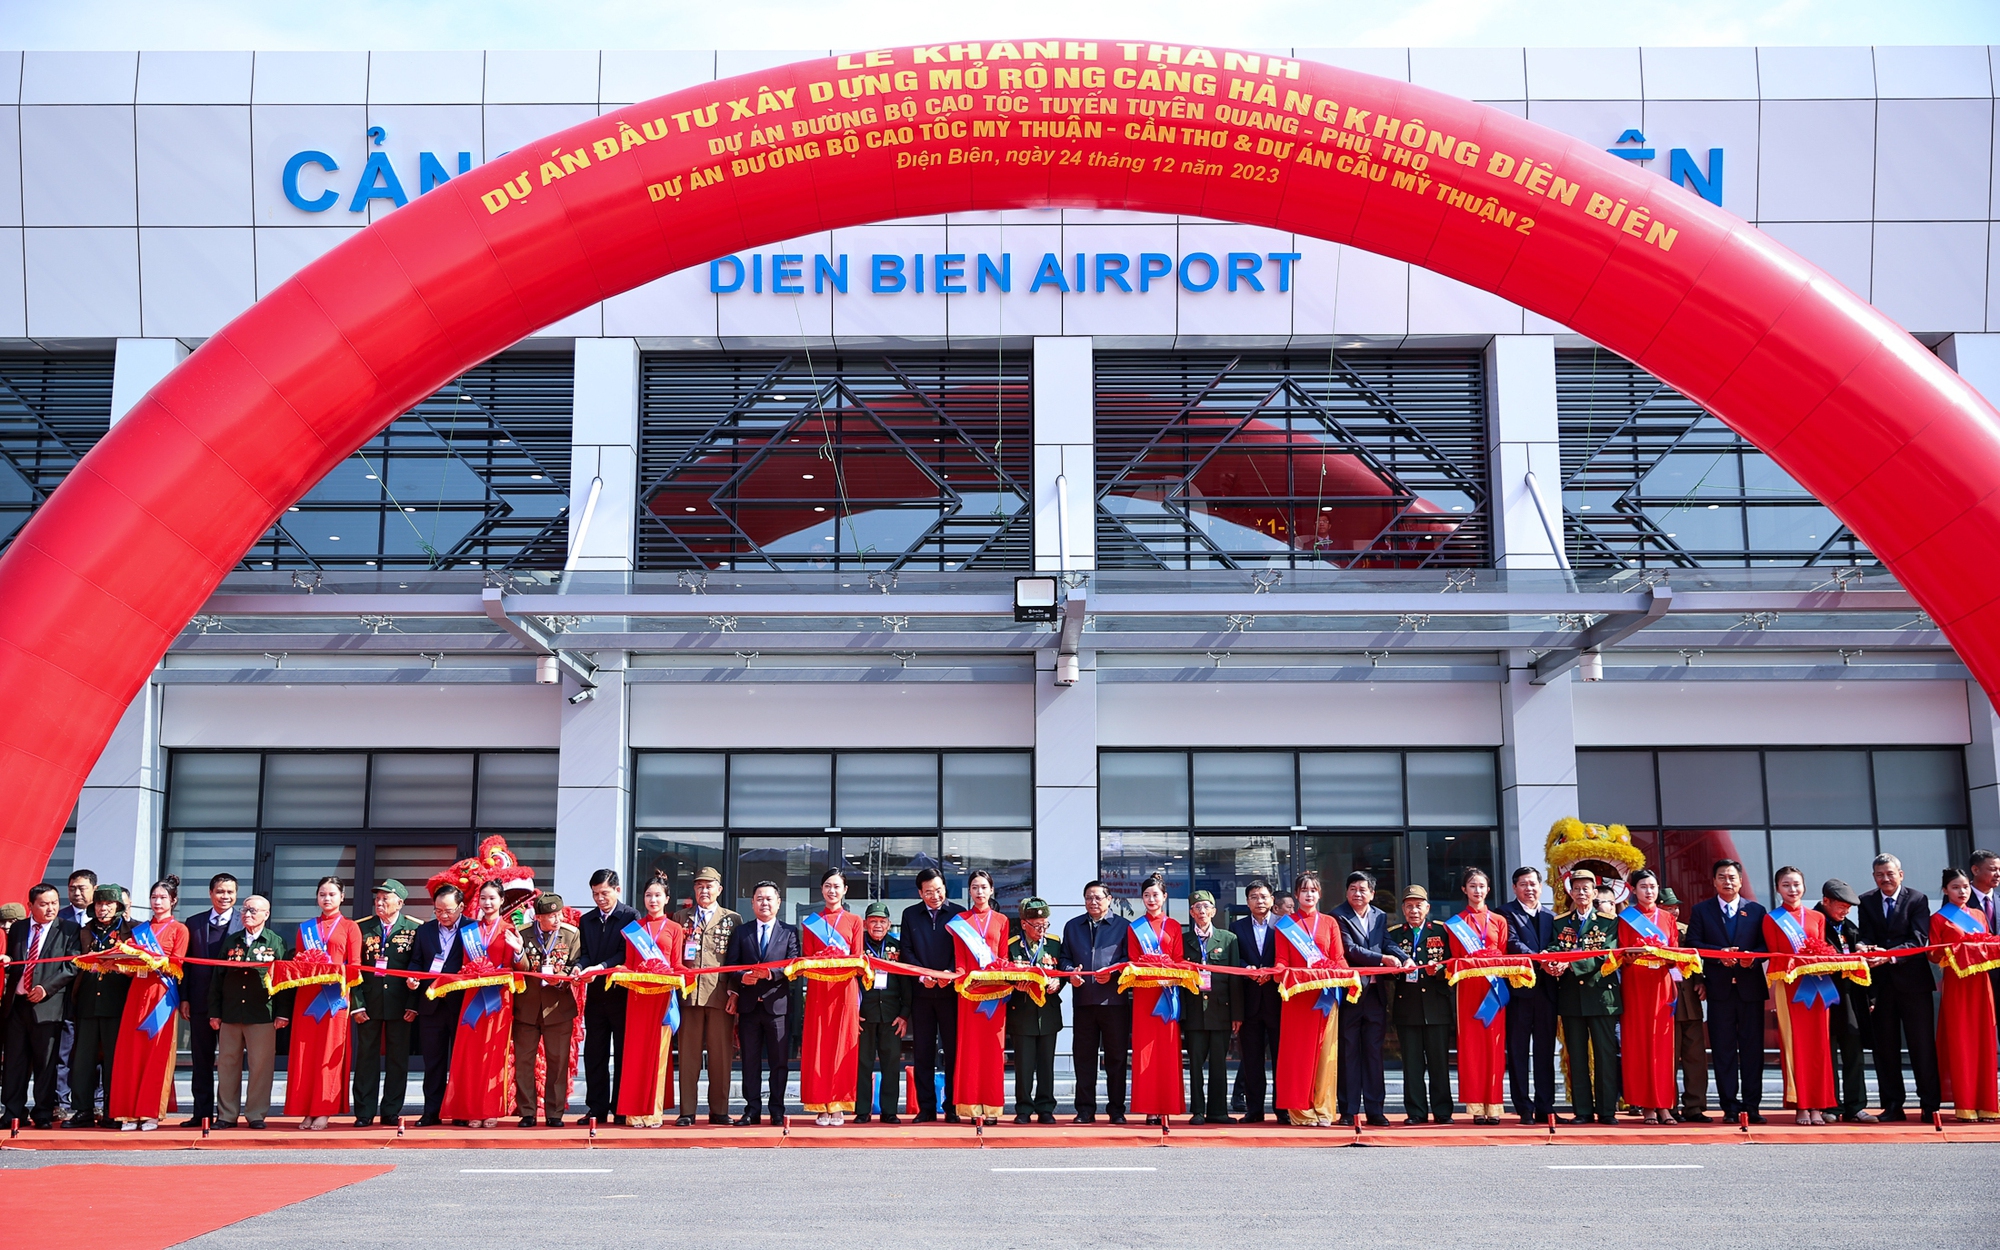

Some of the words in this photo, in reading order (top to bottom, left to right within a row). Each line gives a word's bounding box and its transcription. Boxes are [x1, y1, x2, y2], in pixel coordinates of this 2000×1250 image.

[283, 126, 511, 212] CẢN
[481, 170, 533, 215] DỰ
[539, 146, 592, 186] ÁN
[593, 117, 669, 162] ĐẦU
[671, 101, 720, 132] TƯ
[727, 85, 797, 121] XÂY
[809, 70, 919, 104] DỰNG
[929, 61, 989, 90] MỞ
[999, 62, 1106, 93] RỘNG
[1113, 63, 1217, 97] CẢNG
[1228, 77, 1340, 125] HÀNG
[1343, 106, 1481, 168] KHÔNG
[647, 175, 684, 203] DỰ
[690, 165, 725, 191] ÁN
[731, 141, 821, 178] ĐƯỜNG
[826, 129, 860, 159] BỘ
[865, 126, 914, 150] CAO
[919, 111, 967, 141] TỐC
[973, 113, 1011, 138] MỸ
[1018, 114, 1102, 143] THUẬN
[1124, 116, 1177, 145] CẦN
[1181, 127, 1230, 149] THƠ
[1233, 133, 1254, 153] &
[1255, 136, 1296, 164] DỰ
[1295, 140, 1334, 170] ÁN
[1336, 151, 1389, 184] CẦU
[1391, 170, 1434, 196] MỸ
[1436, 183, 1517, 229] THUẬN
[1515, 215, 1536, 237] 2
[708, 131, 743, 155] DỰ
[750, 122, 785, 147] ÁN
[791, 107, 878, 139] ĐƯỜNG
[884, 96, 918, 122] BỘ
[925, 94, 974, 115] CAO
[983, 89, 1029, 113] TỐC
[1039, 89, 1118, 115] TUYẾN
[1126, 95, 1205, 120] TUYÊN
[1214, 104, 1300, 136] QUANG
[1319, 126, 1373, 155] PHÚ
[1382, 142, 1430, 176] THỌ
[1005, 145, 1056, 167] ngày
[1058, 149, 1083, 167] 24
[1087, 151, 1147, 174] tháng
[1150, 155, 1175, 174] 12
[1180, 158, 1225, 177] năm
[1230, 162, 1281, 185] 2023
[709, 252, 849, 295] DIEN
[871, 252, 1011, 294] BIEN
[1029, 252, 1302, 293] AIRPORT
